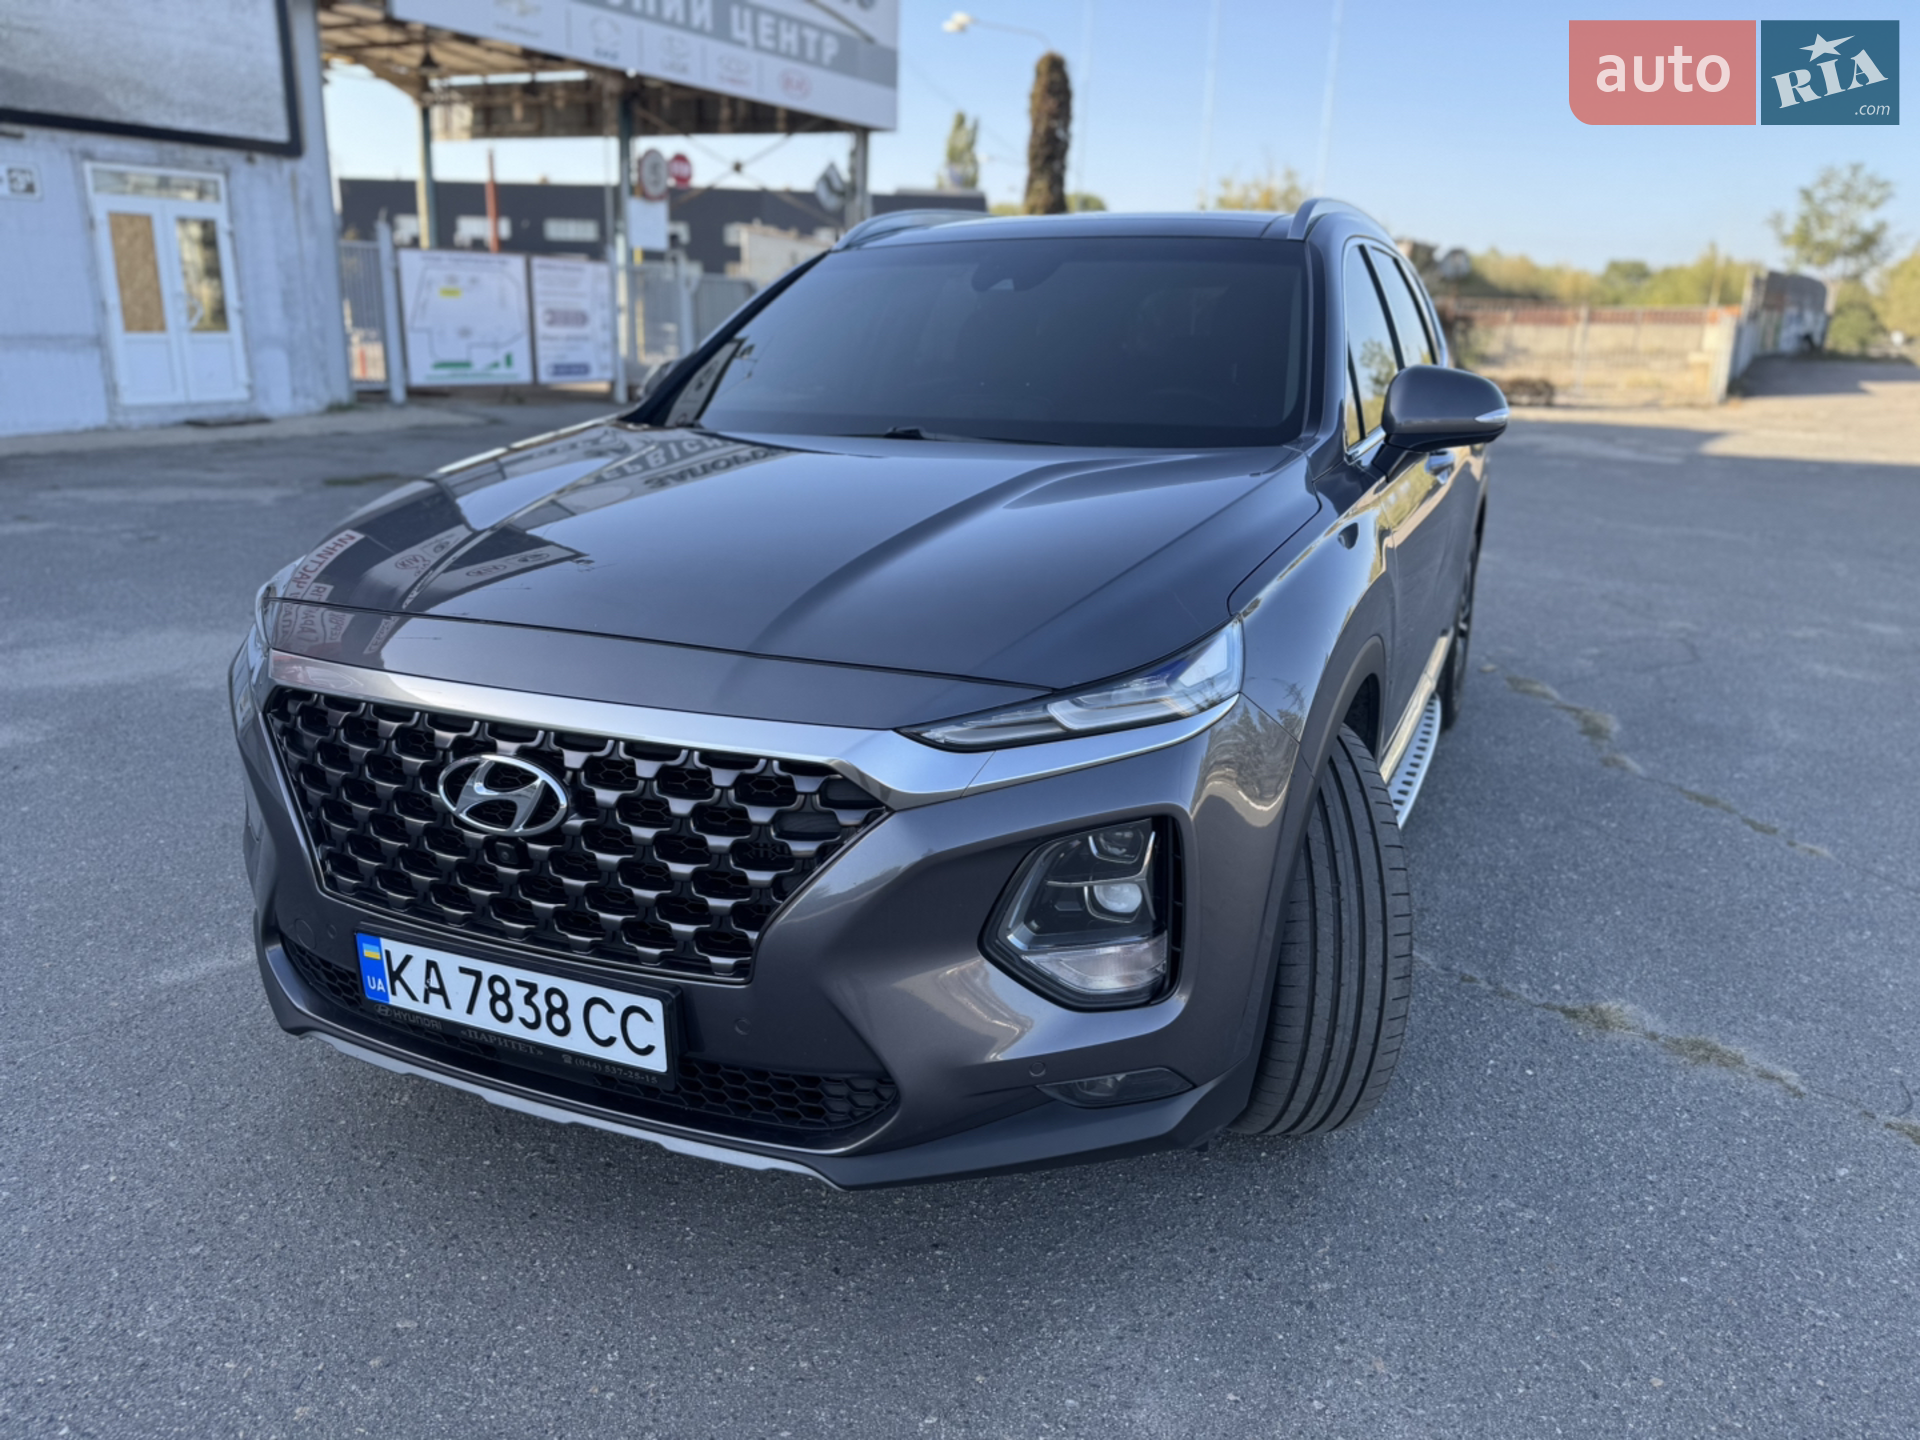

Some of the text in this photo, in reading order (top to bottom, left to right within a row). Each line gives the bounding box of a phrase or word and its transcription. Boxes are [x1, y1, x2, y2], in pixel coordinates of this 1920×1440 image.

[729, 4, 840, 66] ЦЕНТР
[367, 975, 386, 993] UA
[385, 949, 656, 1056] KA 7838 CC
[393, 1009, 443, 1031] HYUNDAI
